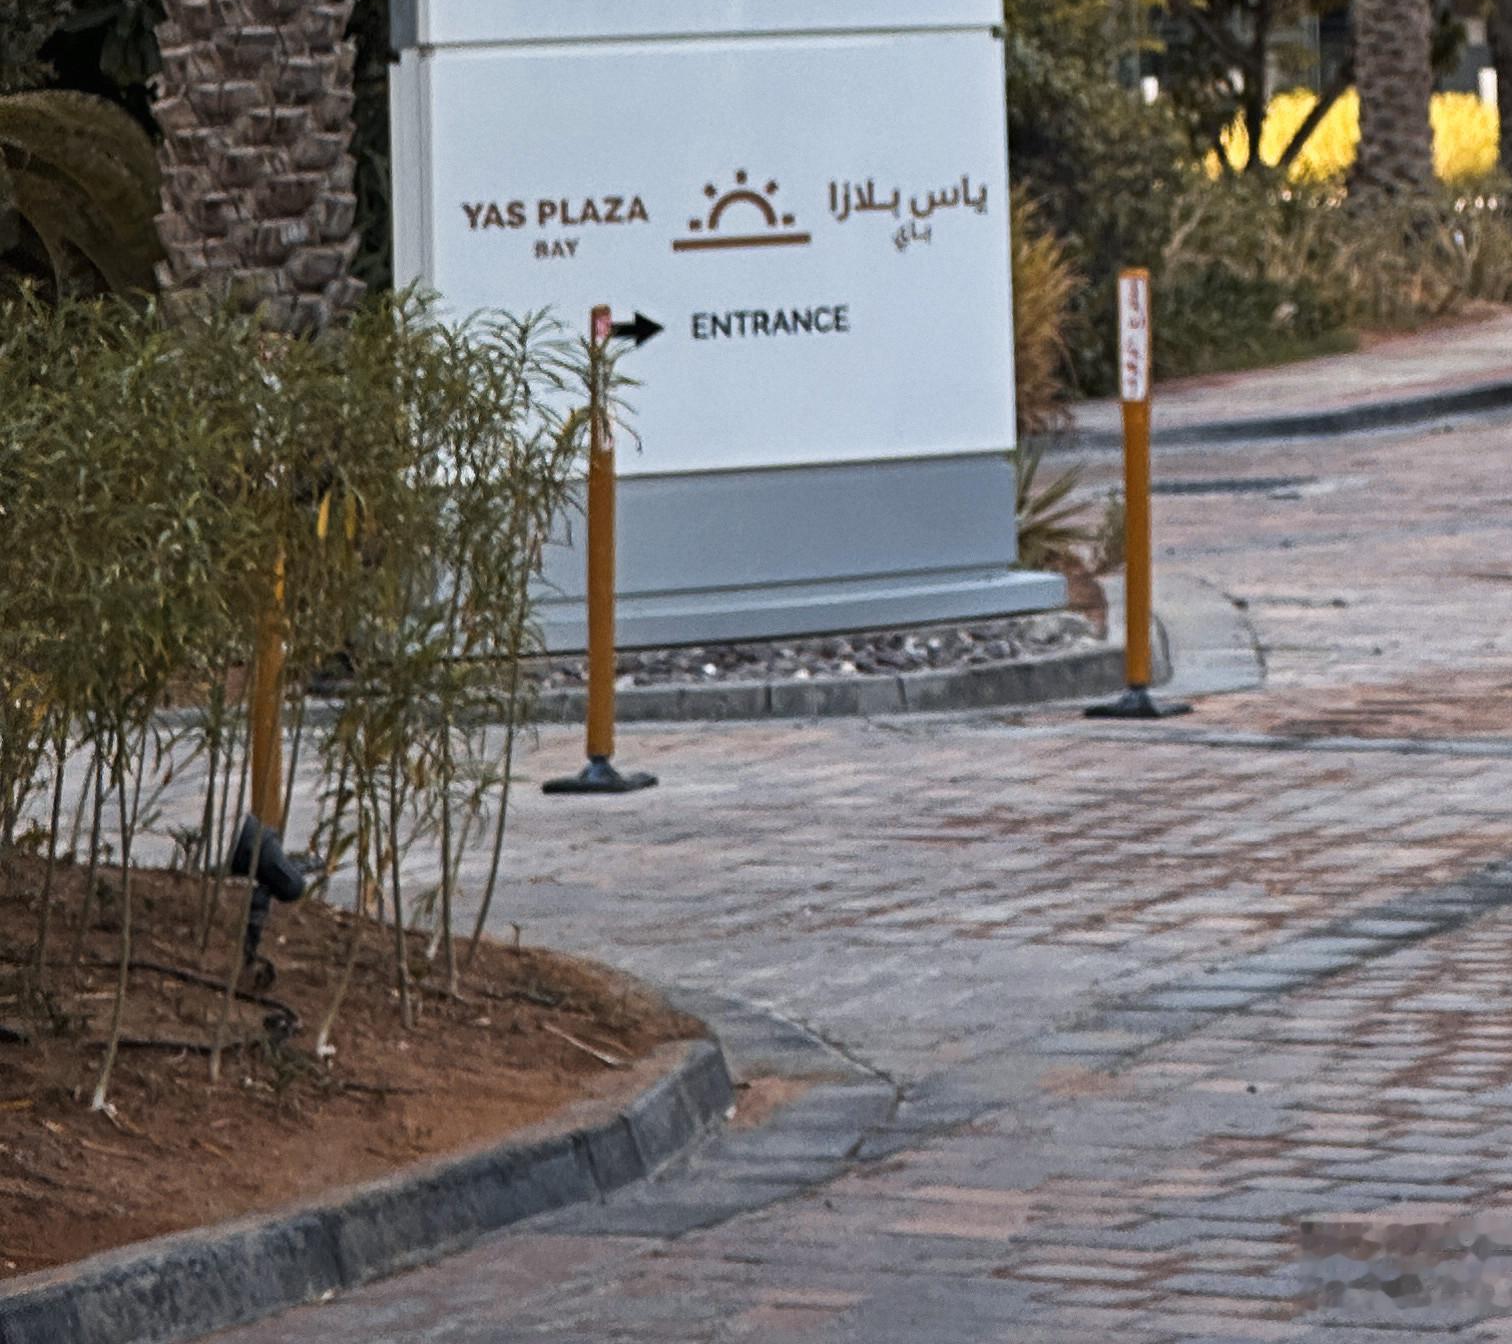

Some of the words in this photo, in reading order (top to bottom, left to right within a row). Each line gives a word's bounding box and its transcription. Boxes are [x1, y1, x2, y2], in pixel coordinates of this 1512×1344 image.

[462, 200, 527, 231] YAS
[538, 194, 649, 227] PLAZA
[829, 176, 900, 222] بلازا
[910, 173, 988, 219] ياس
[534, 237, 579, 259] BAY
[691, 305, 849, 340] ENTRANCE
